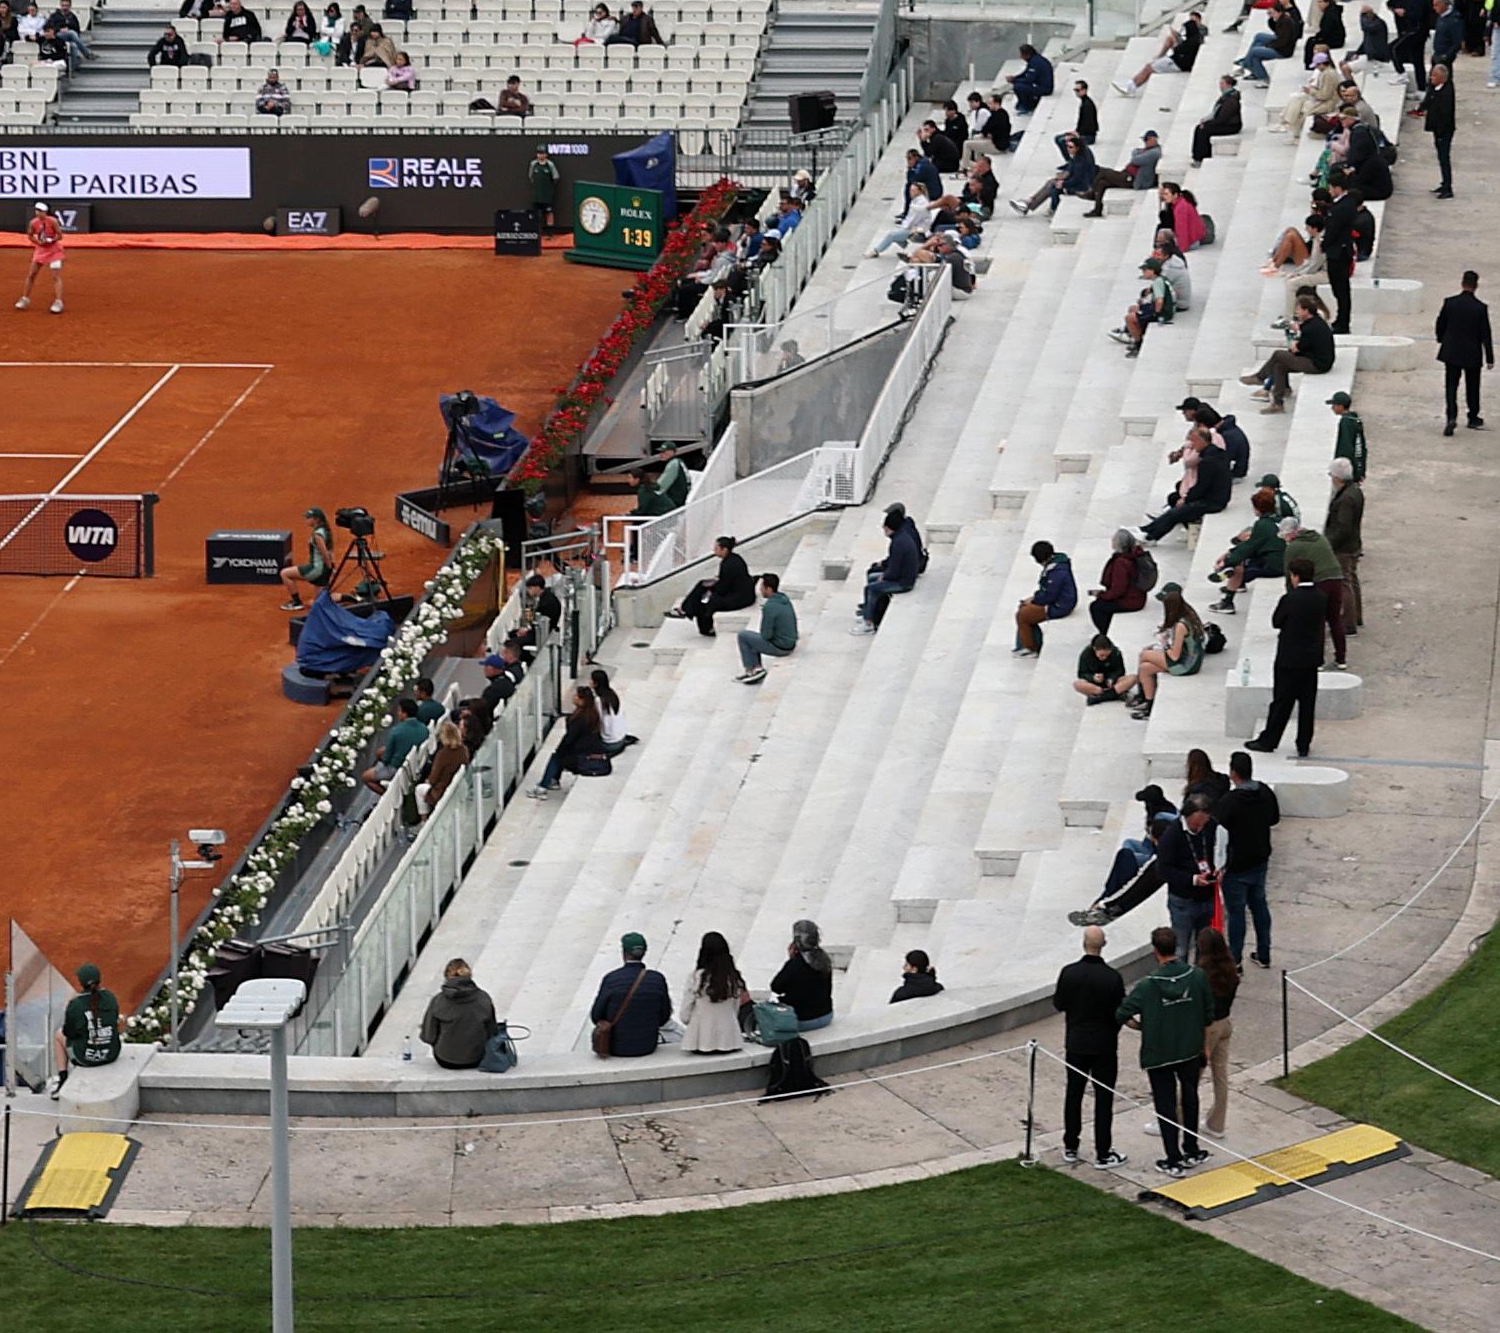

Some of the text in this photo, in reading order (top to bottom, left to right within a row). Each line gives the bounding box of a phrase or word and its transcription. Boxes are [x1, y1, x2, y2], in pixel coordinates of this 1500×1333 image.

[402, 157, 483, 175] REALE
[69, 173, 198, 195] PARIBAS
[402, 175, 483, 188] MUTUA
[288, 212, 328, 229] EA7
[620, 207, 653, 221] ROLEX
[622, 227, 653, 248] 1:39
[68, 525, 115, 545] WTA
[227, 557, 278, 569] YOKOHAMA
